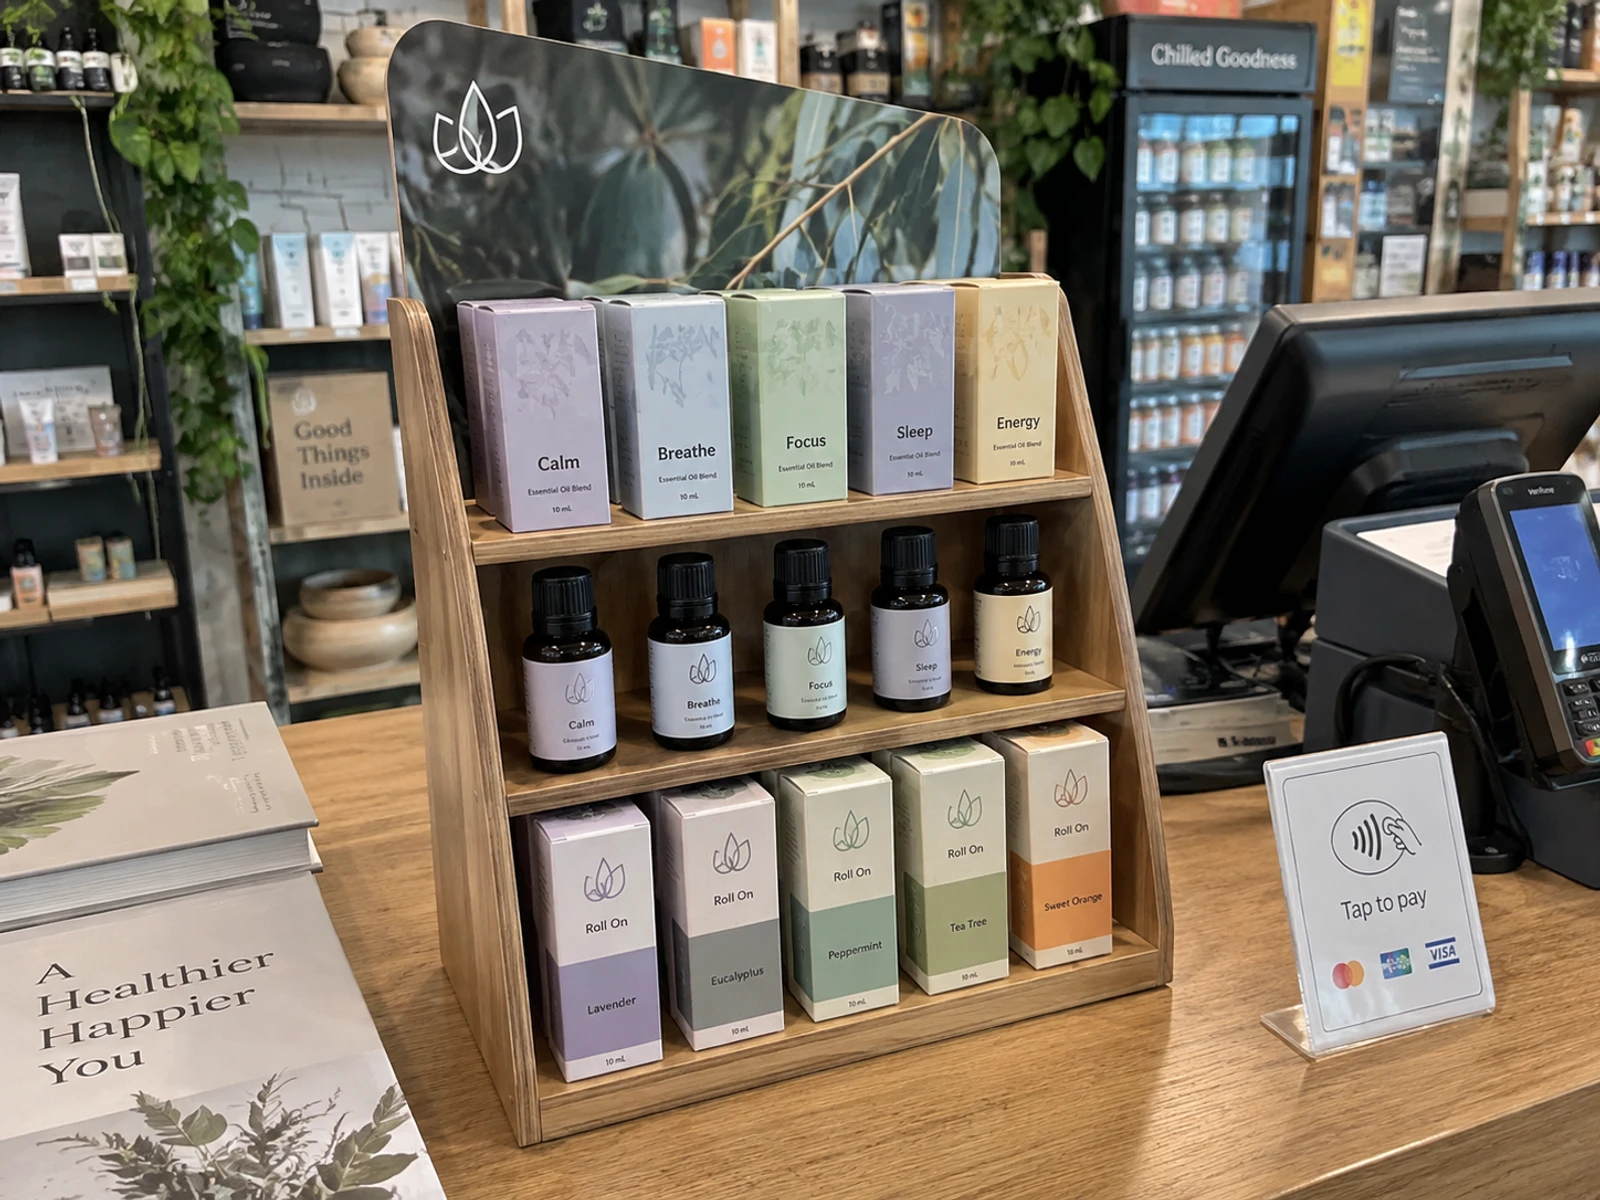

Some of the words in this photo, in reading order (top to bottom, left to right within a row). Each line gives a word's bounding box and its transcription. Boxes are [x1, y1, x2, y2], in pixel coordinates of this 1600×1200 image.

[1151, 43, 1213, 67] Chilled
[1216, 45, 1297, 69] Goodness
[294, 416, 352, 440] Good
[997, 416, 1040, 430] Energy
[897, 425, 933, 440] Sleep
[786, 436, 826, 449] Focus
[297, 442, 370, 465] Things
[658, 443, 716, 460] Breathe
[538, 455, 580, 471] Calm
[301, 467, 364, 491] Inside
[658, 474, 687, 483] Essential
[699, 472, 717, 480] Blend
[528, 486, 559, 496] Essential
[560, 485, 570, 493] Oil
[572, 484, 592, 492] Blend
[1015, 647, 1042, 658] Energy
[916, 662, 937, 673] Sleep
[808, 680, 834, 691] Focus
[687, 697, 721, 710] Breathe
[568, 719, 595, 730] Calm
[1054, 825, 1072, 837] Roll
[1075, 823, 1089, 833] On
[948, 847, 967, 859] Roll
[969, 844, 984, 855] On
[834, 869, 853, 882] Roll
[856, 867, 872, 878] On
[714, 894, 735, 906] Roll
[738, 889, 754, 901] On
[1044, 900, 1070, 912] Sweet
[1071, 893, 1103, 906] Orange
[1340, 901, 1373, 921] Tap
[1375, 896, 1394, 913] to
[1397, 889, 1427, 913] pay
[585, 918, 607, 934] Roll
[611, 917, 628, 929] On
[950, 922, 966, 933] Tea
[967, 918, 987, 929] Tree
[828, 941, 883, 960] Peppermint
[1430, 944, 1457, 961] VISA
[35, 962, 75, 985] A
[37, 952, 274, 1017] Healthier
[587, 996, 637, 1016] Lavender
[39, 988, 255, 1051] Happier
[38, 1050, 145, 1086] You
[605, 1058, 614, 1066] 10
